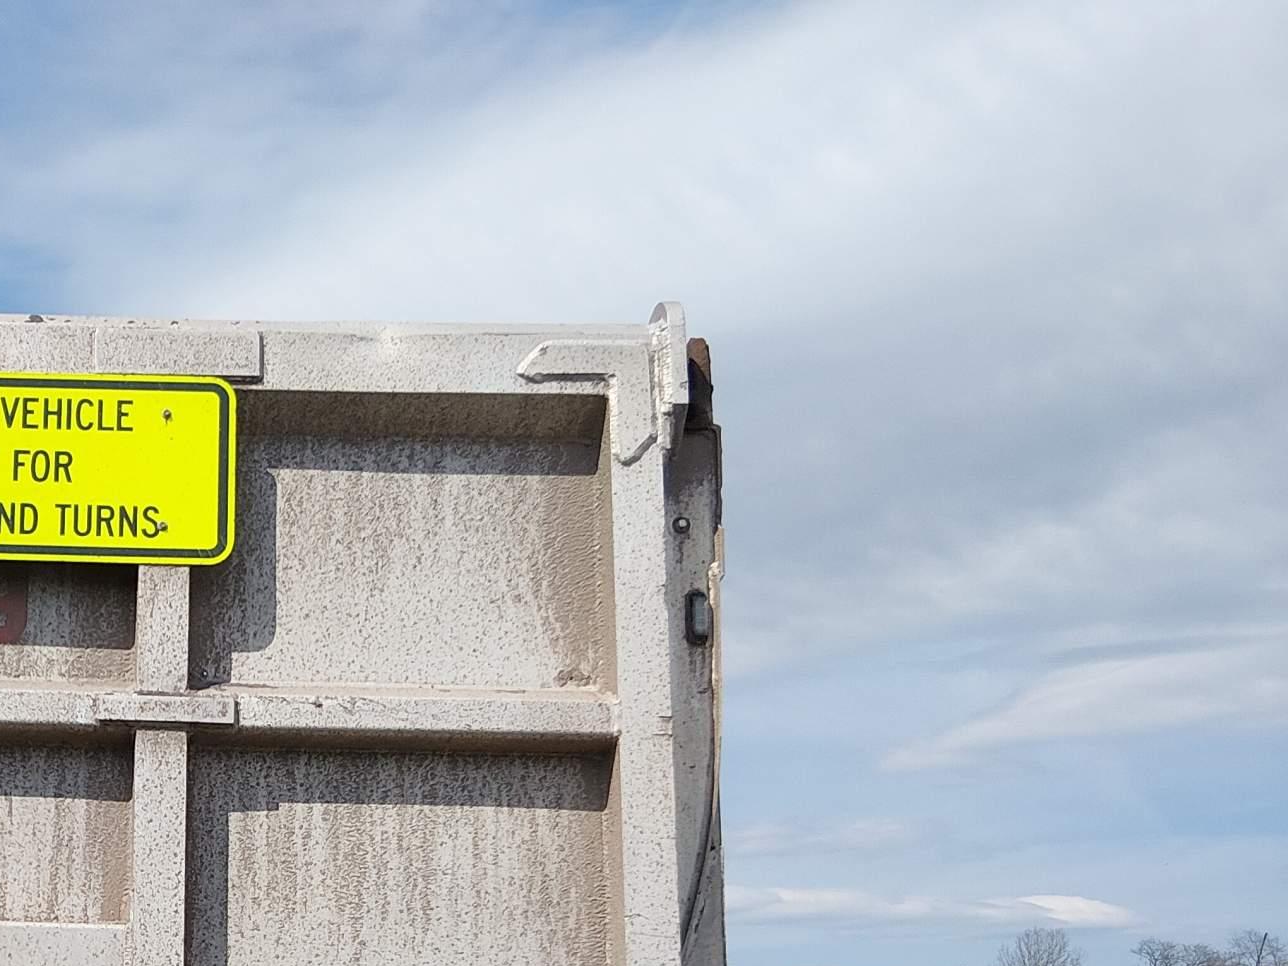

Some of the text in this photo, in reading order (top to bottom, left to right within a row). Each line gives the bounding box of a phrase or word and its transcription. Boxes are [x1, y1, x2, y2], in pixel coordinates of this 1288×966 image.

[1, 396, 134, 432] VEHICLE
[13, 449, 73, 483] FOR
[55, 503, 159, 538] TURNS
